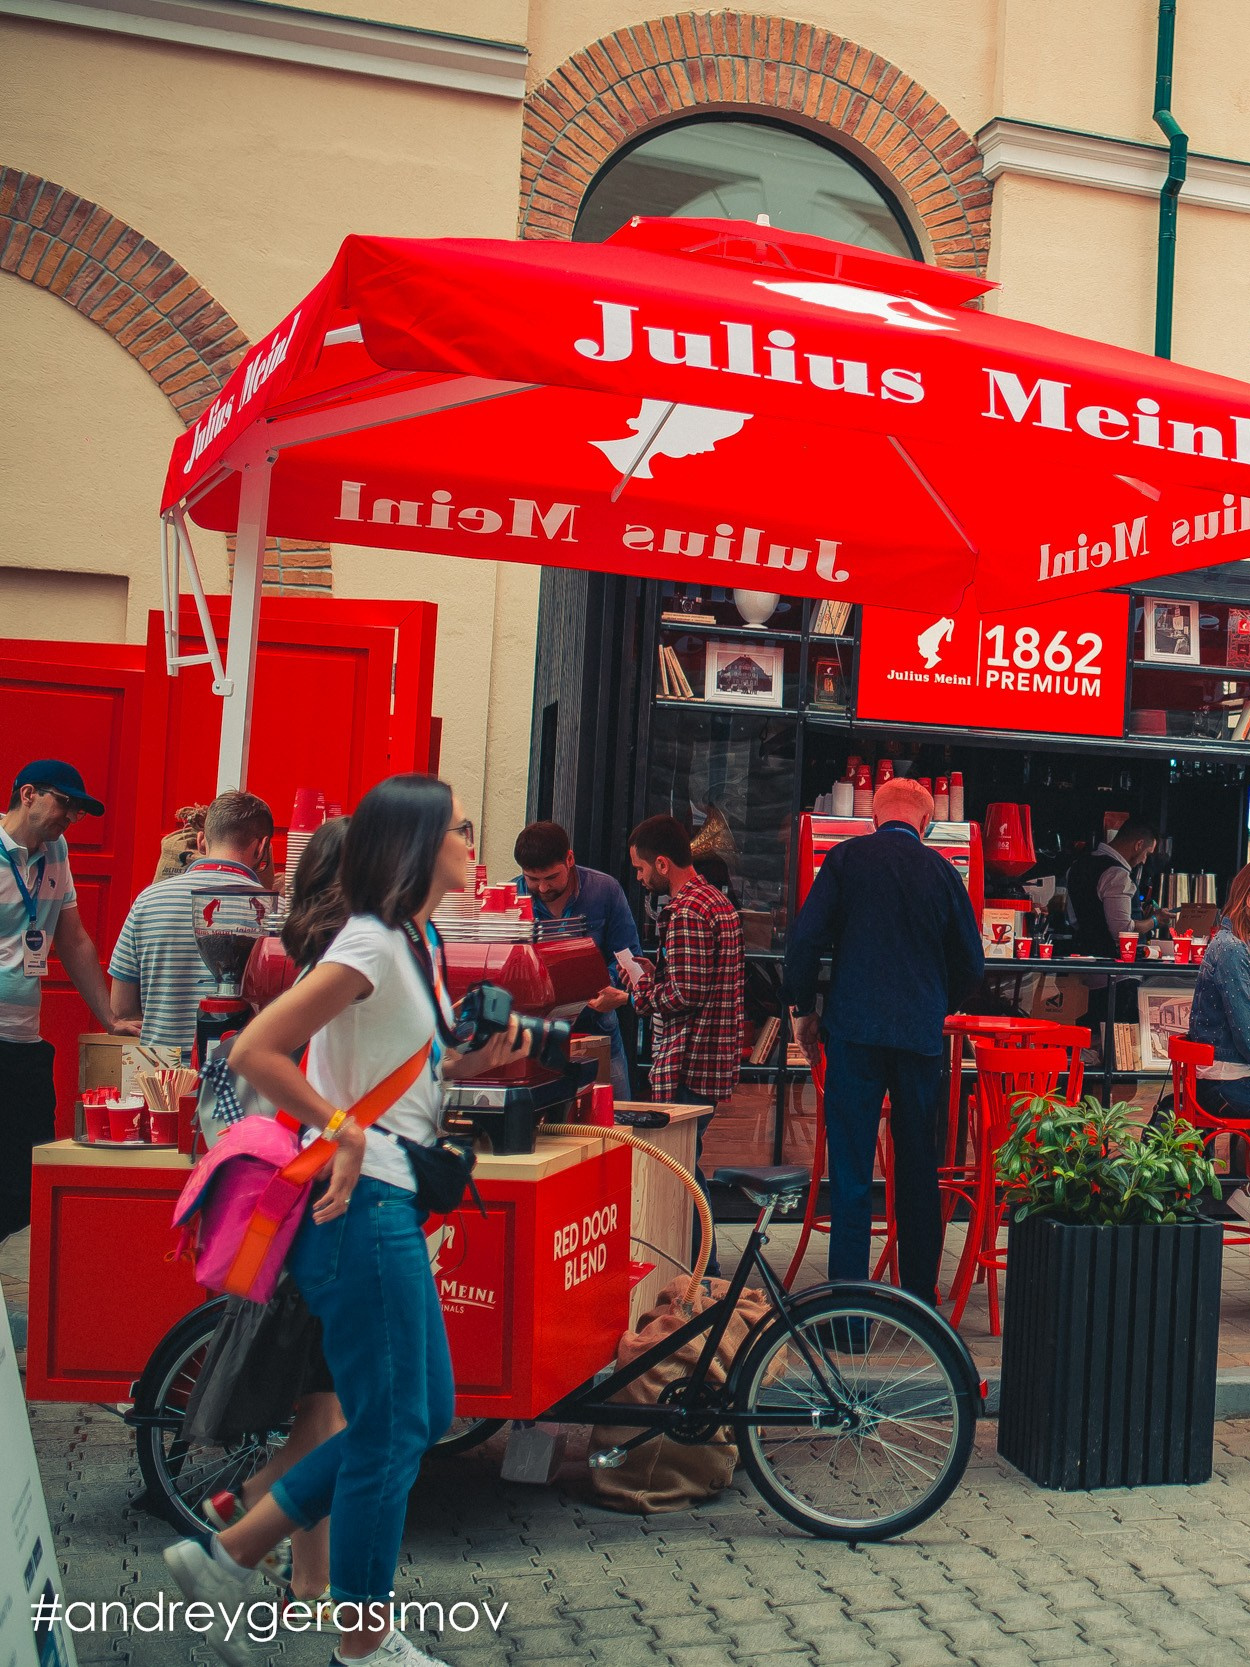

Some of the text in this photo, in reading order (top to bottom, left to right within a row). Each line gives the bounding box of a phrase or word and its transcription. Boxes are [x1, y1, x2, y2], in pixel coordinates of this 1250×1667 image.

[573, 300, 926, 405] Julius
[183, 309, 302, 474] Julius Meinl
[985, 624, 1103, 675] 1862
[887, 669, 972, 686] Julius Meinl
[985, 670, 1101, 698] PREMIUM
[553, 1203, 618, 1261] RED DOOR
[564, 1242, 607, 1291] BLEND
[440, 1279, 496, 1304] MEINL
[441, 1304, 465, 1314] INALS
